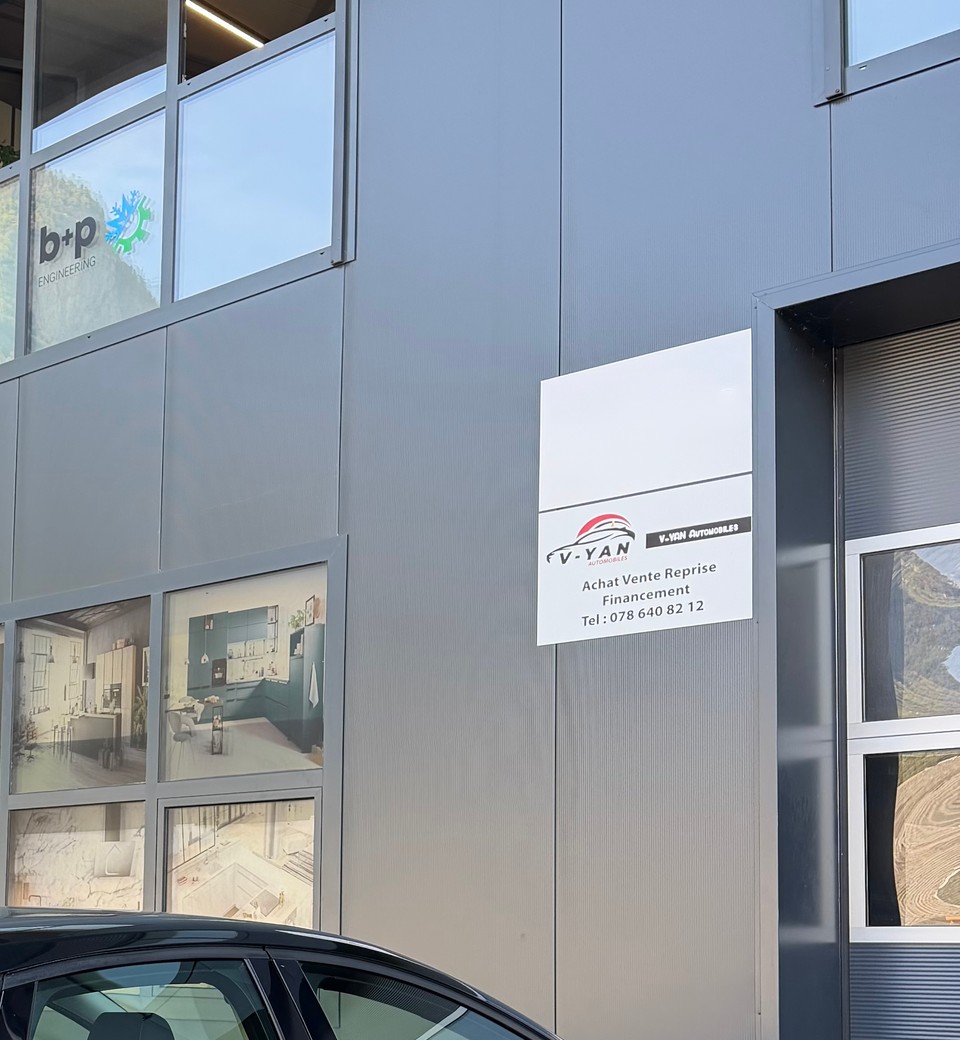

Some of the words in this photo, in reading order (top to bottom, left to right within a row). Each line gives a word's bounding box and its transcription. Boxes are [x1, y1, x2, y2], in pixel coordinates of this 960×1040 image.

[39, 216, 97, 264] b+p
[38, 256, 96, 288] ENGINEERING
[659, 531, 687, 543] V-YAN
[560, 542, 630, 565] V-YAN
[588, 556, 628, 566] AUTOMOBILES
[582, 577, 620, 592] Achat
[622, 571, 661, 585] Vente
[665, 563, 717, 579] Reprise
[602, 584, 690, 606] Financement
[610, 610, 634, 623] 078
[638, 606, 663, 619] 640
[666, 603, 683, 615] 82
[688, 600, 704, 612] 12
